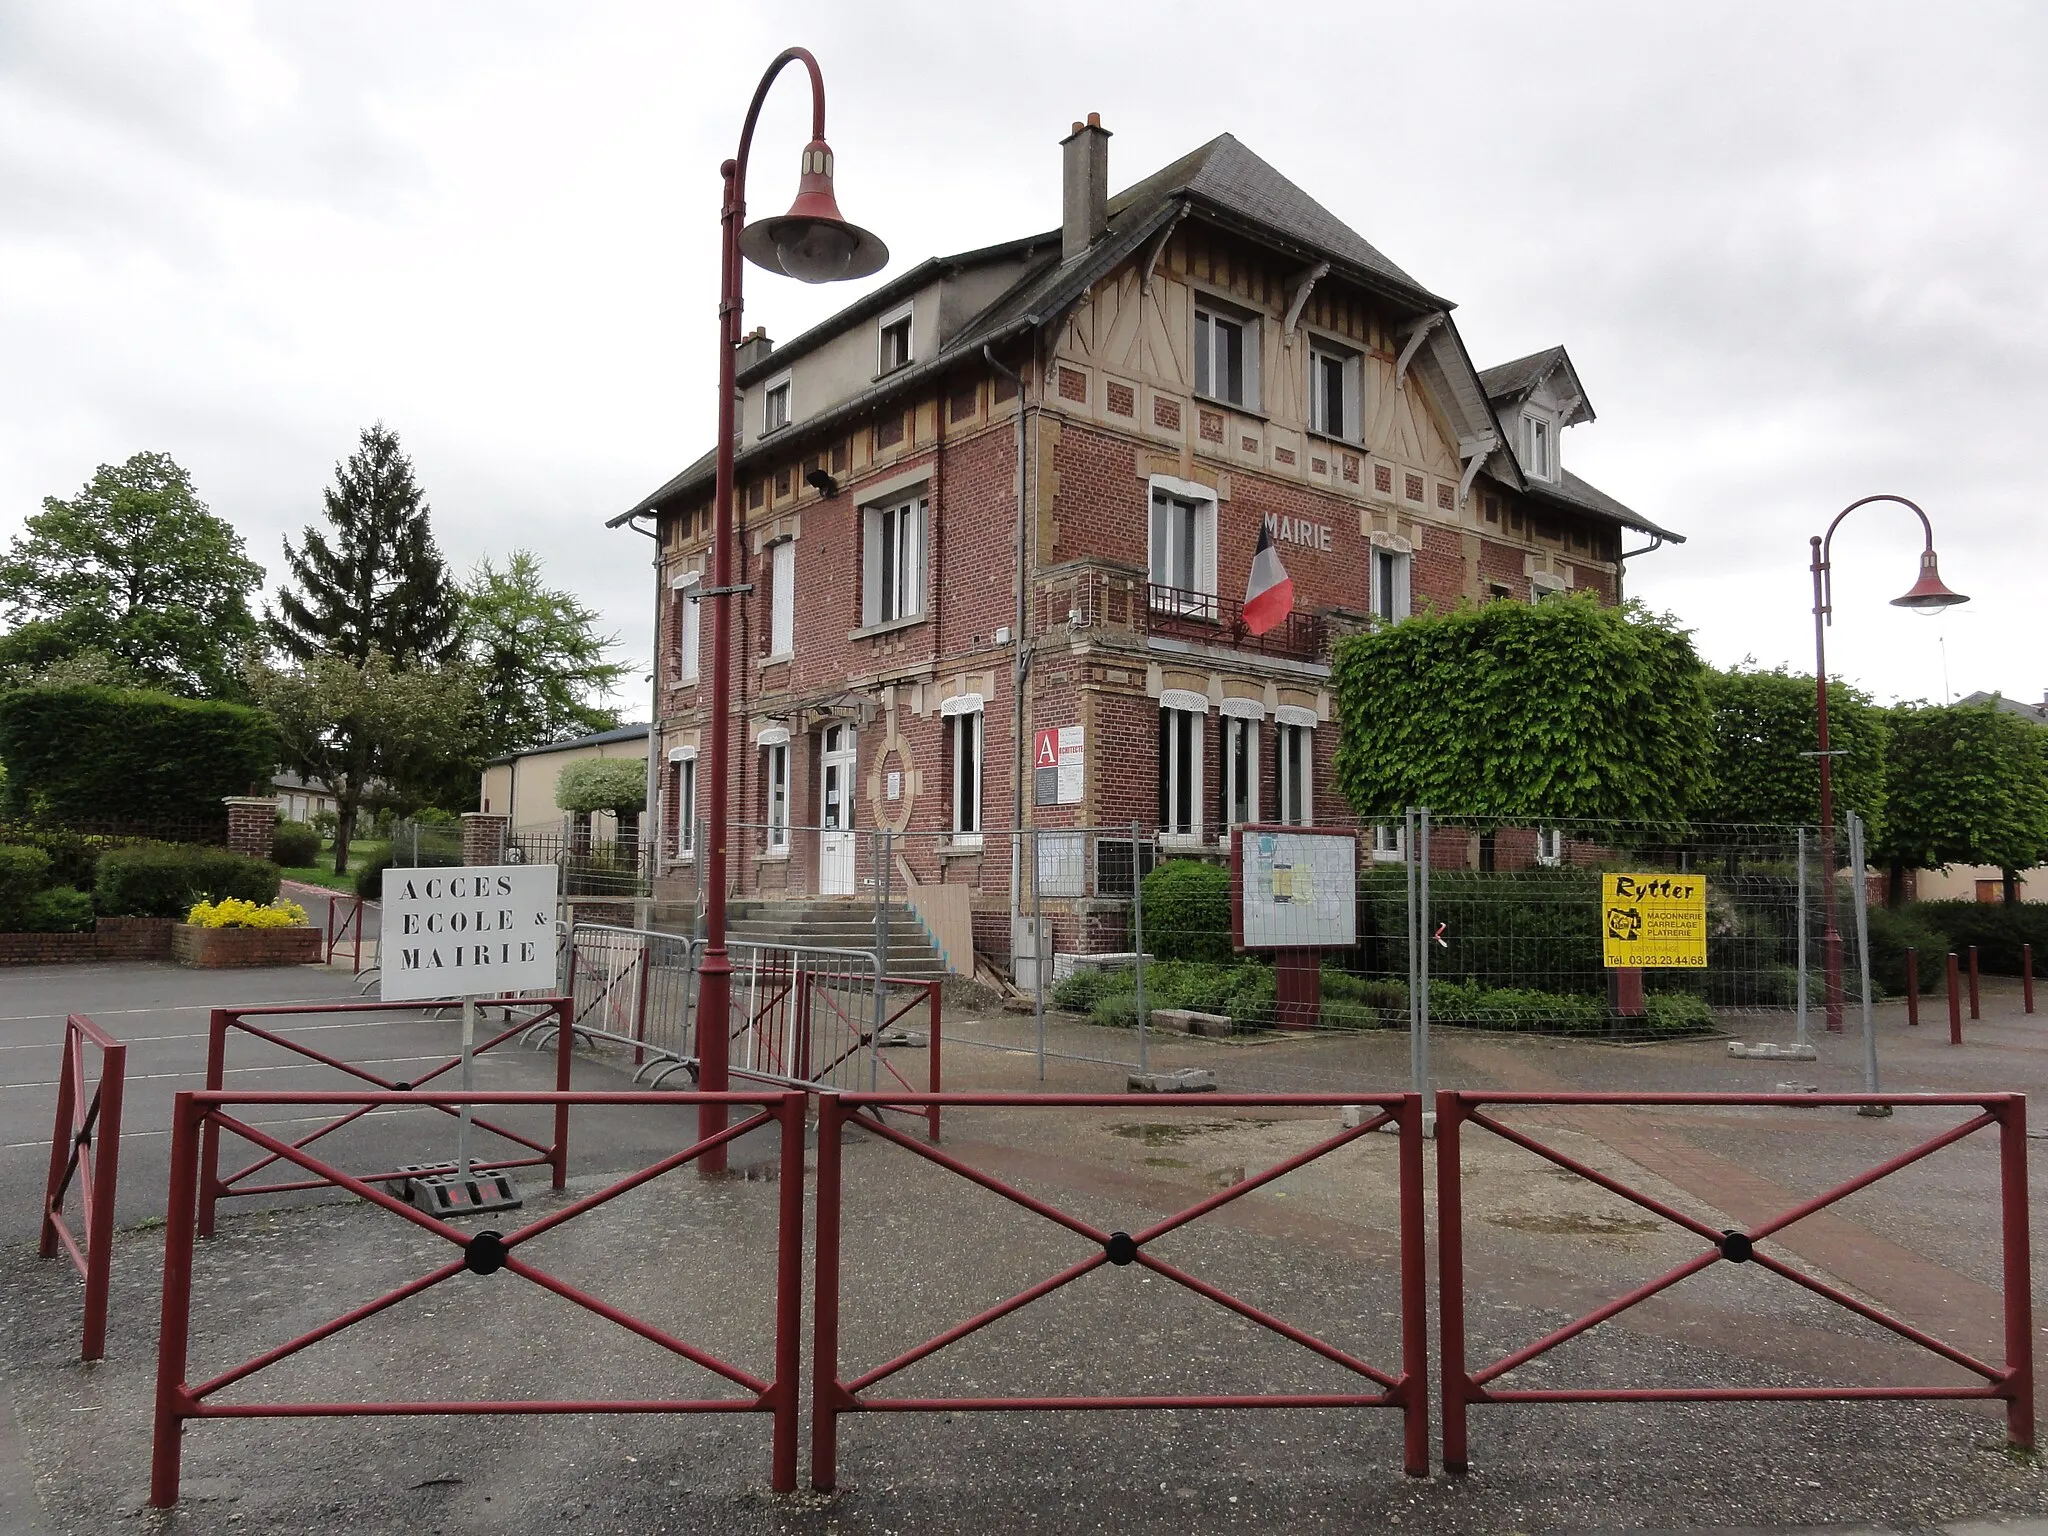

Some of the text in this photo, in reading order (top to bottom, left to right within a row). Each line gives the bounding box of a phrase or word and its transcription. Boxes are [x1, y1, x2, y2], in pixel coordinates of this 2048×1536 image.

[1264, 511, 1333, 552] MAIRIE
[1037, 733, 1056, 764] A
[399, 876, 512, 900] ACCES
[1616, 877, 1694, 902] Rytter
[402, 909, 548, 935] ECOLE &
[1647, 913, 1703, 922] MAÇONNERIE
[1647, 921, 1698, 929] CARRELAGE
[401, 942, 535, 970] MAIRIE
